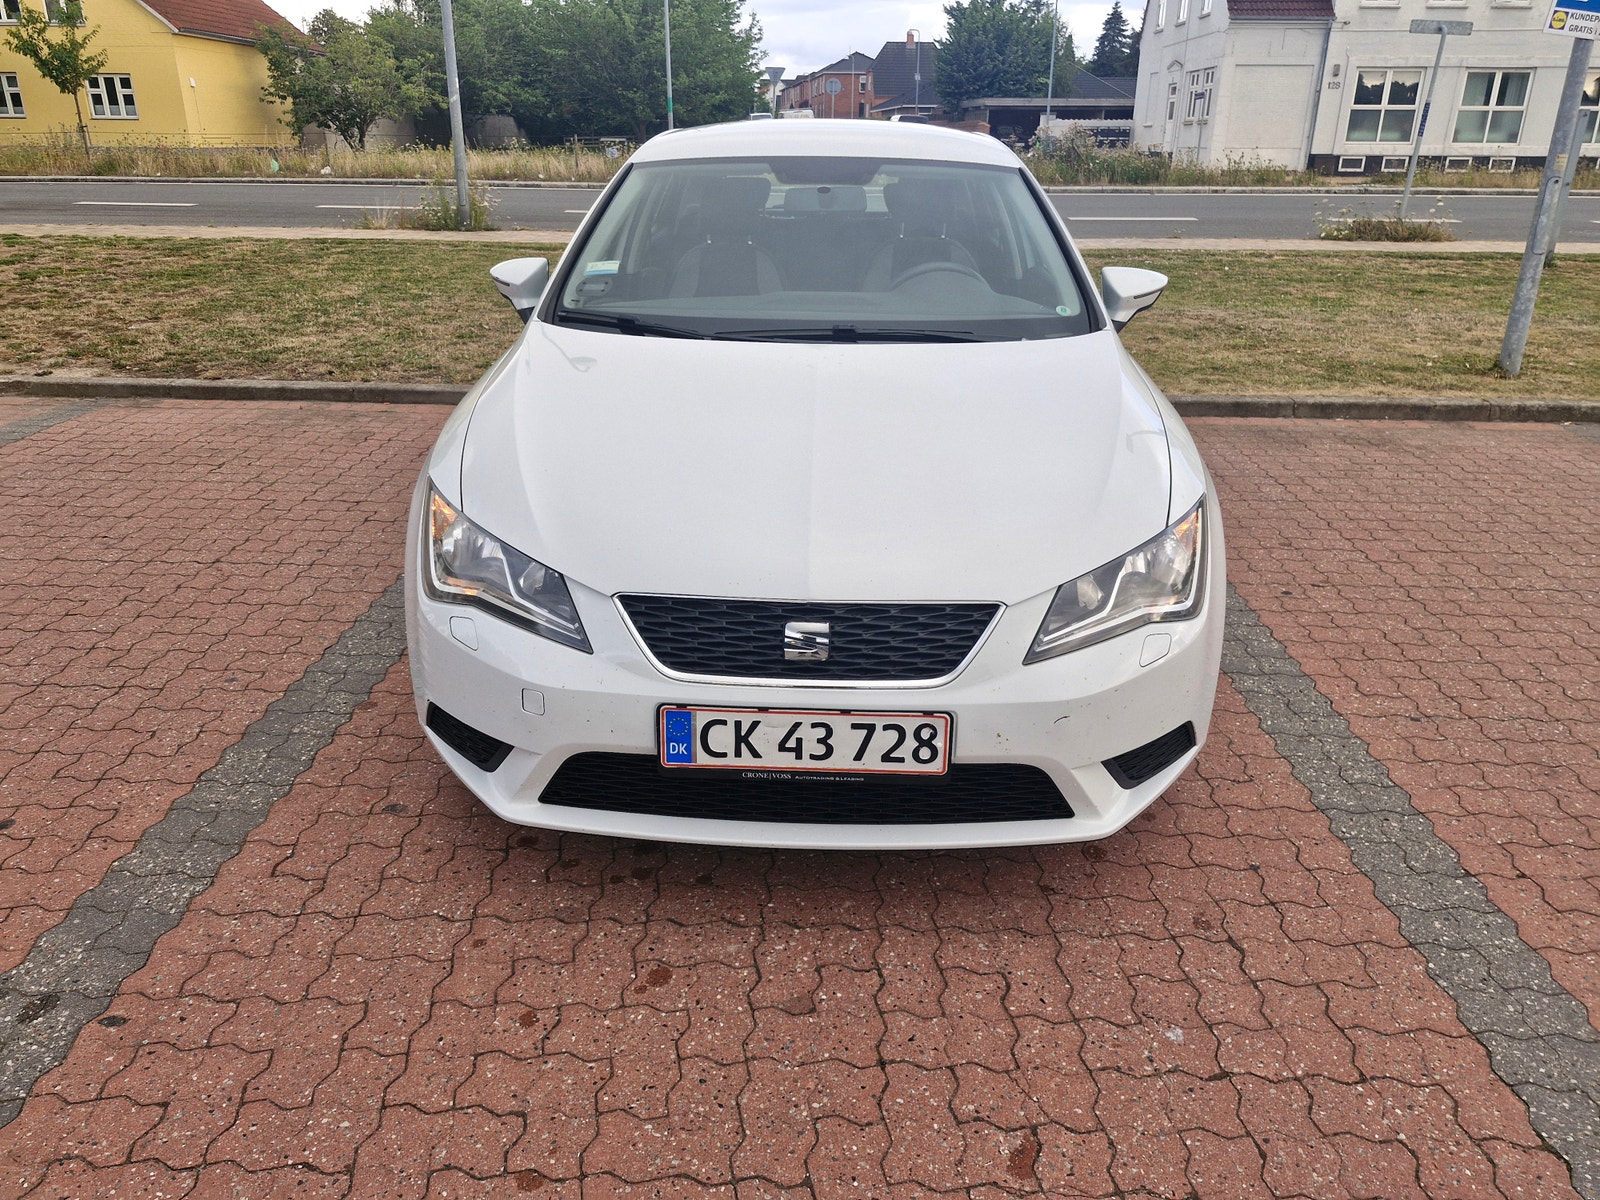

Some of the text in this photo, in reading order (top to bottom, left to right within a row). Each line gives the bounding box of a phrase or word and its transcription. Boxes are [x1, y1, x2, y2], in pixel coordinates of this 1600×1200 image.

[1570, 12, 1600, 23] KUNDEP
[1568, 24, 1593, 35] GRATIS
[699, 718, 939, 765] CK 43 728
[669, 742, 688, 755] DK
